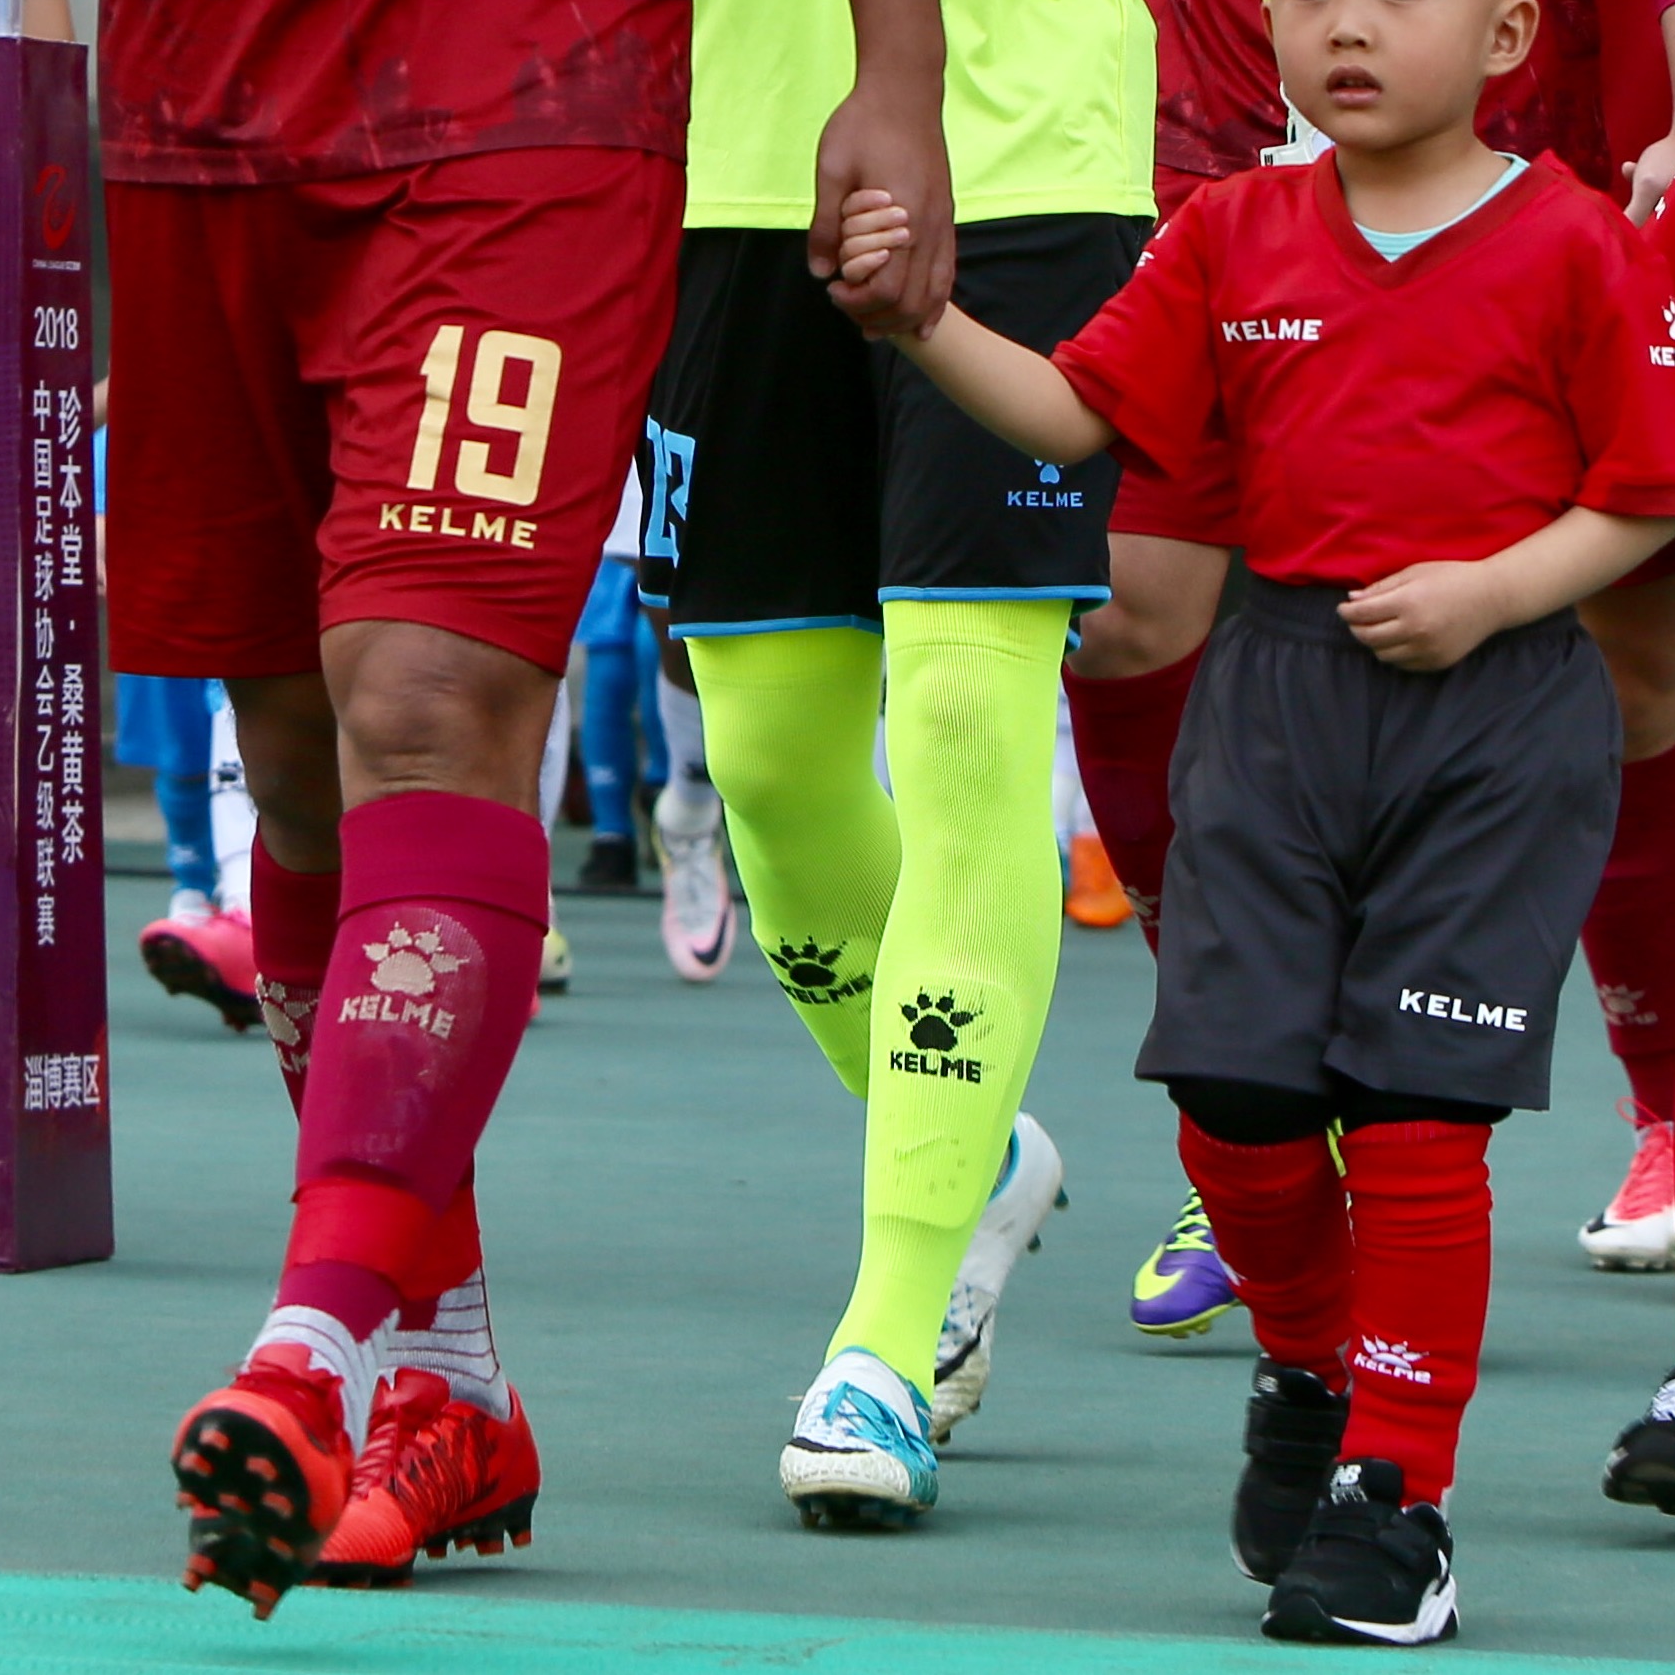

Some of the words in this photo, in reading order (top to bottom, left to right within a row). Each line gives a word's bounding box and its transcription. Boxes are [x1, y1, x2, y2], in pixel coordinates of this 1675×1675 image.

[34, 306, 79, 350] 2018
[1222, 318, 1322, 341] KELME
[407, 325, 562, 506] 19
[1007, 490, 1083, 508] KELME
[379, 502, 537, 549] KELME
[33, 379, 56, 947] 中国足球协会乙级联赛
[338, 994, 456, 1040] KELME
[1399, 986, 1527, 1033] KELME
[23, 1054, 101, 1111] 淄博赛区
[890, 1051, 982, 1083] KELME
[1354, 1352, 1432, 1385] KELME
